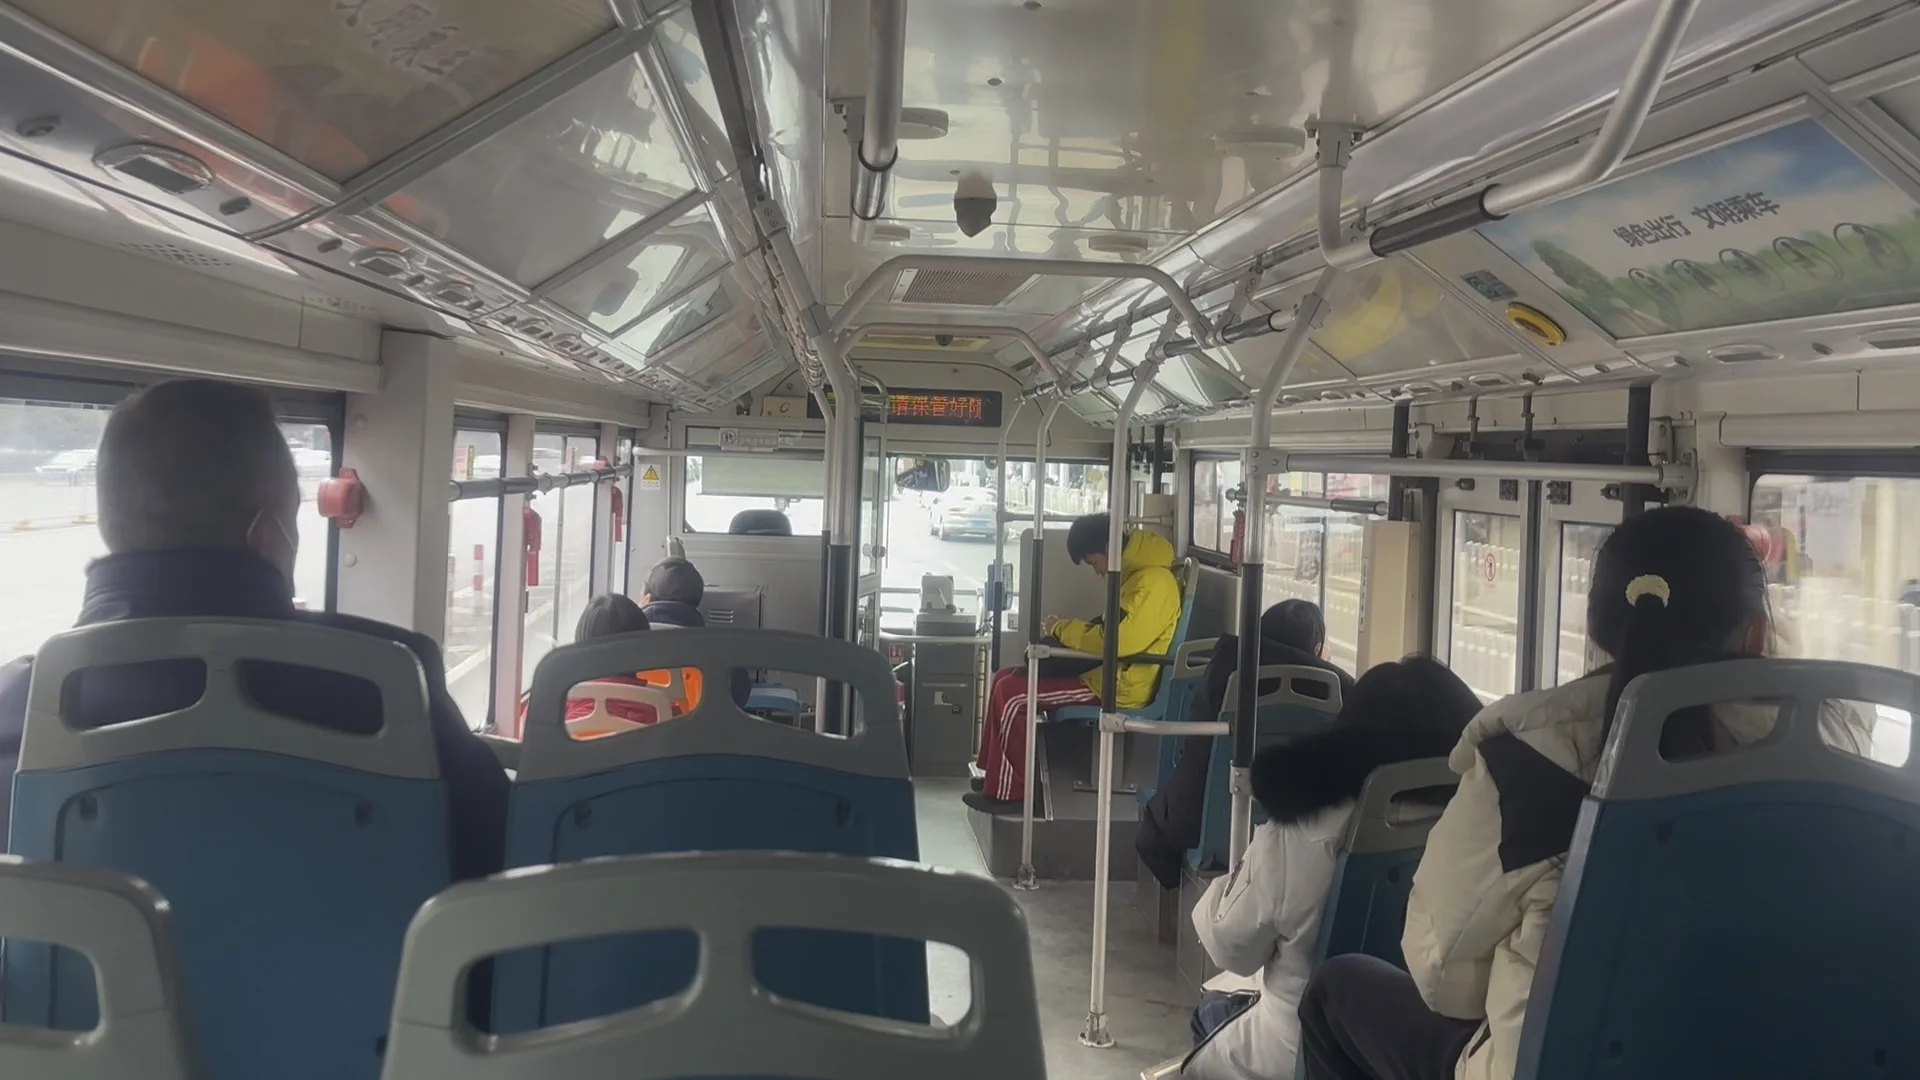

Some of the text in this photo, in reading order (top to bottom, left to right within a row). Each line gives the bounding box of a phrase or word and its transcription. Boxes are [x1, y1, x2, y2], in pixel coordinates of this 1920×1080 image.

[1613, 191, 1781, 248] 绿色出行 文明乘车
